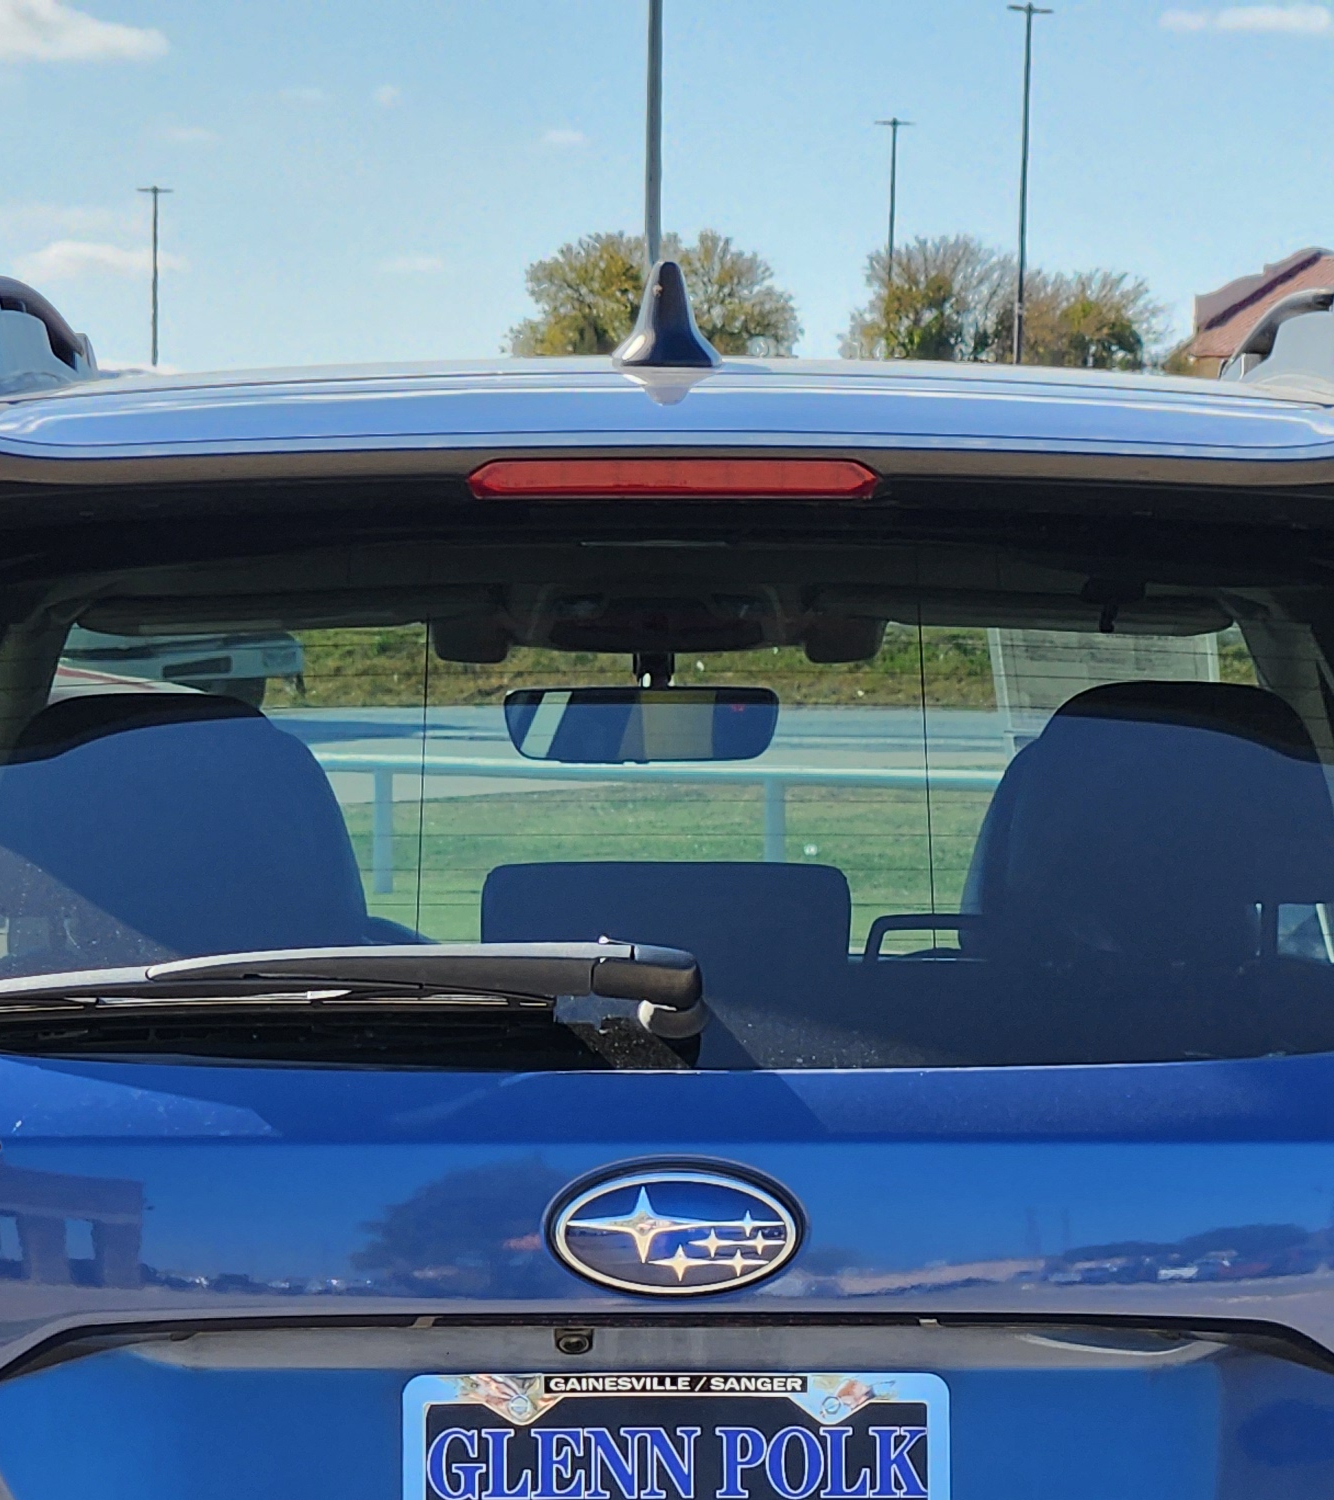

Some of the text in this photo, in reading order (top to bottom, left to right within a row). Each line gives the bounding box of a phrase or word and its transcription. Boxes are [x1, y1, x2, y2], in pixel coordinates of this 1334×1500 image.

[549, 1377, 691, 1391] GAINESVILLE
[709, 1377, 803, 1391] SANGER
[427, 1425, 928, 1500] GLENN POLK
